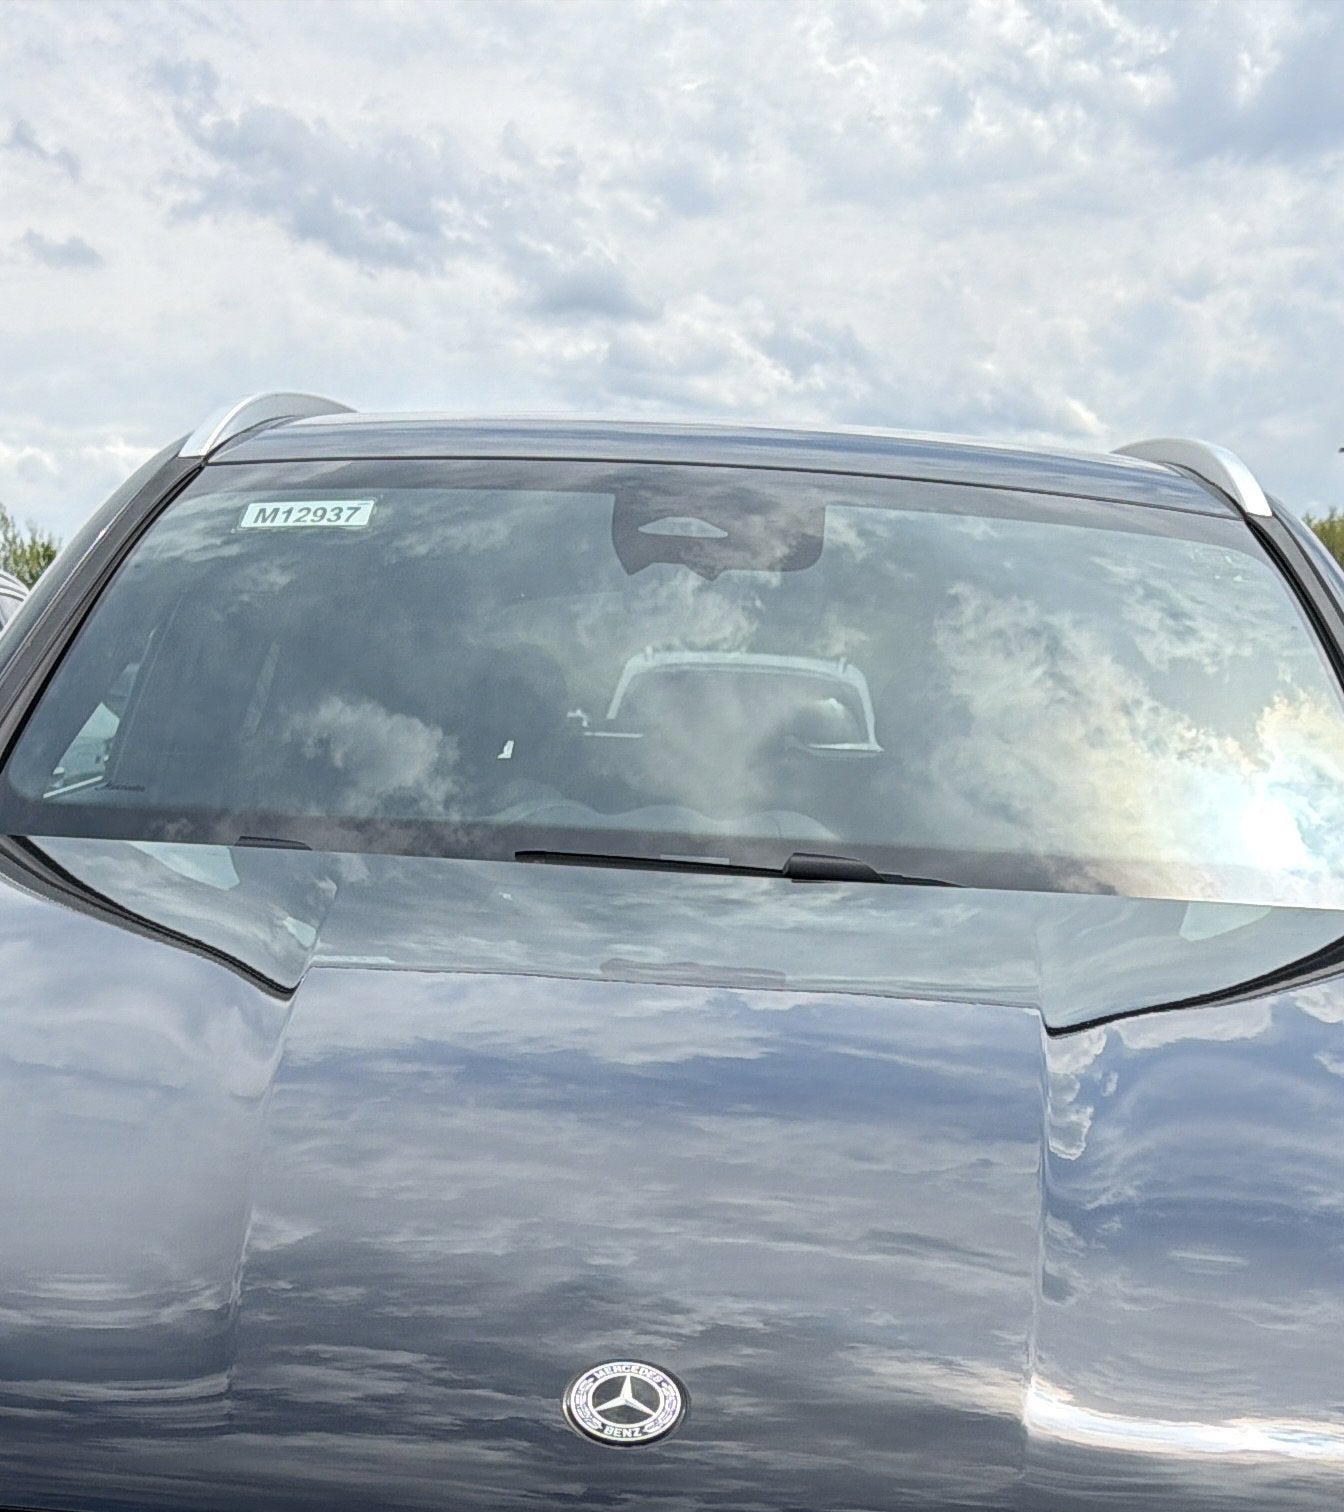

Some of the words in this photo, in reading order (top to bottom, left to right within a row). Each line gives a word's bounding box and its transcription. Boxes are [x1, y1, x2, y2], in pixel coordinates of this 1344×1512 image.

[252, 506, 362, 524] M12937
[594, 1365, 664, 1383] MERCEDES
[603, 1426, 643, 1438] BENZ
